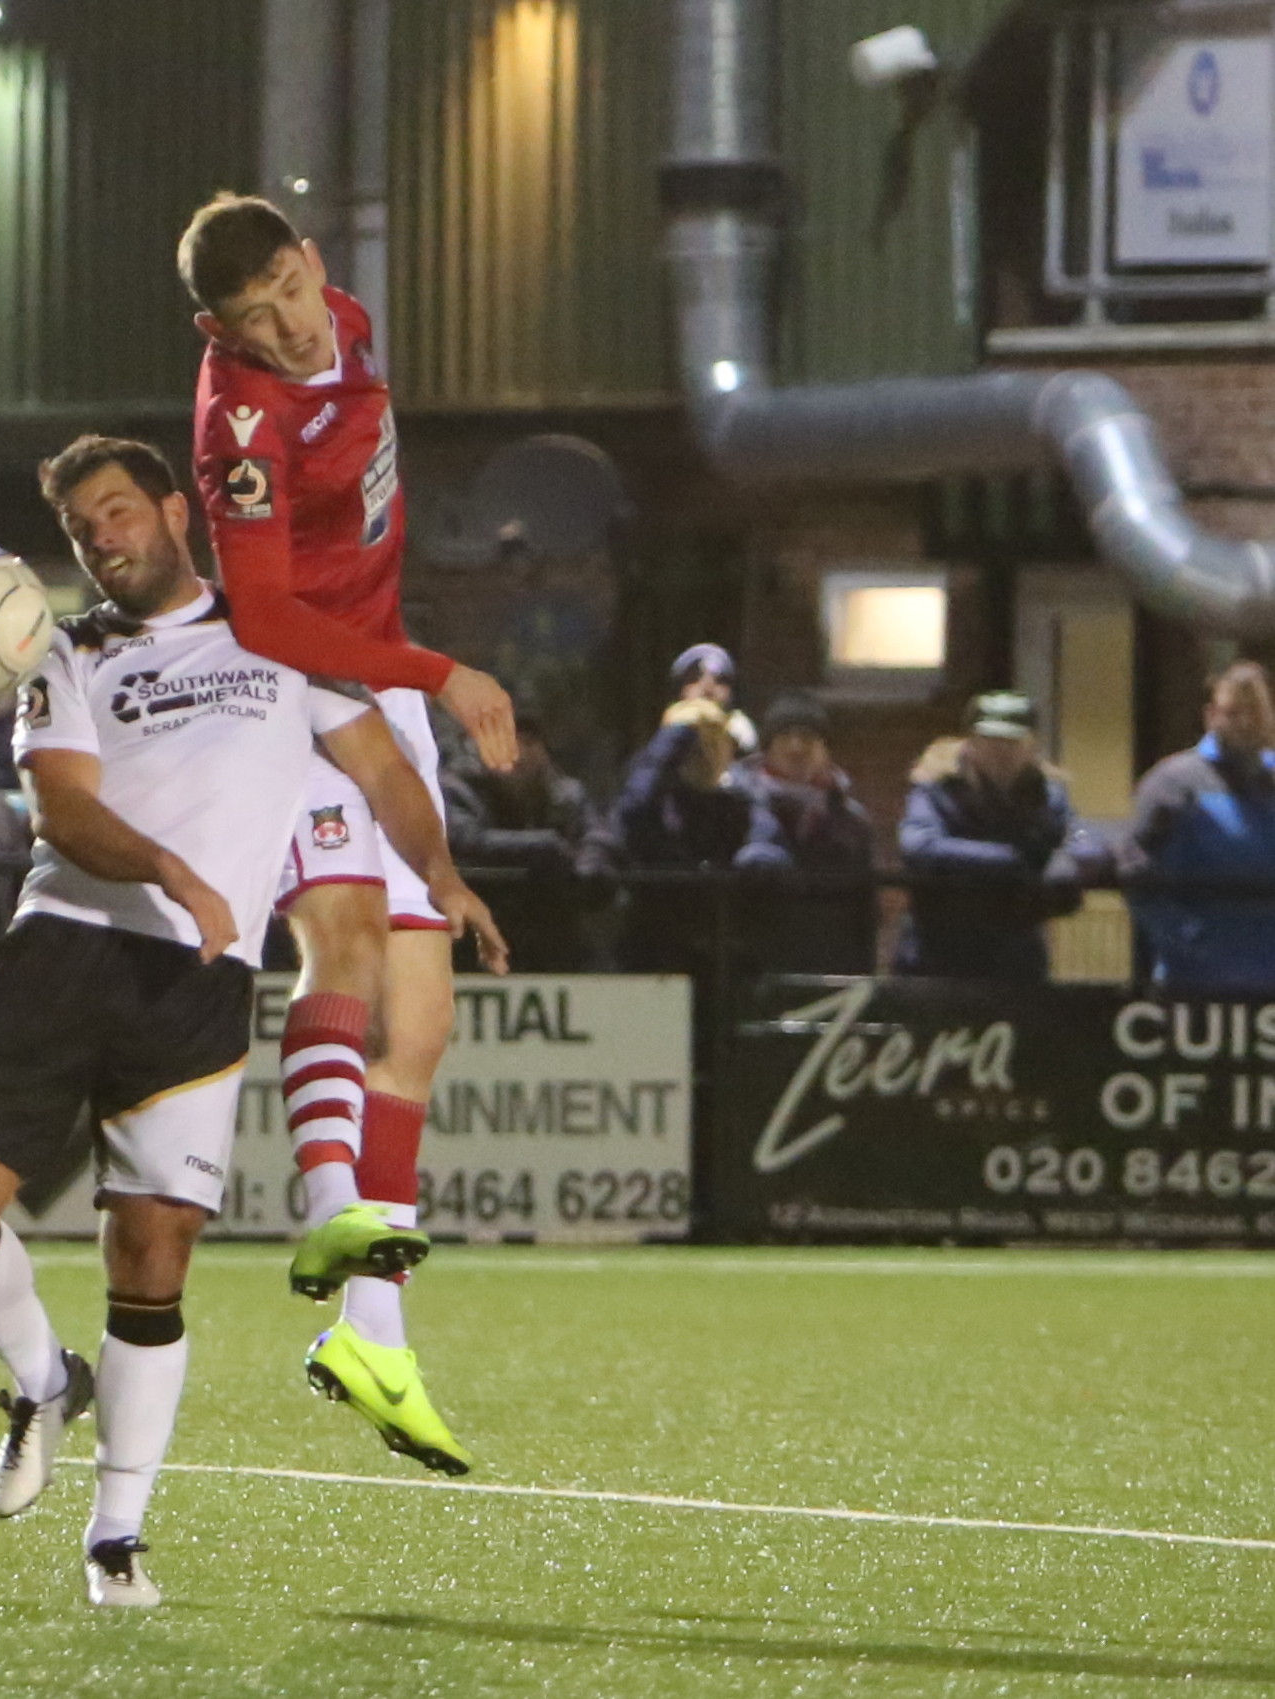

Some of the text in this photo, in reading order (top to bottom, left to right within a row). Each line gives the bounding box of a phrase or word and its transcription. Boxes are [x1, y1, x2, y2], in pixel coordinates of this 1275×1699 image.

[137, 668, 280, 701] SOUTHWARK
[196, 682, 279, 705] METALS
[195, 703, 268, 721] CYCLING
[255, 985, 592, 1043] ETIAL
[753, 977, 1015, 1173] Zeera
[1100, 1072, 1208, 1129] OF
[556, 1167, 691, 1223] 6228
[984, 1146, 1275, 1197] 020 8462
